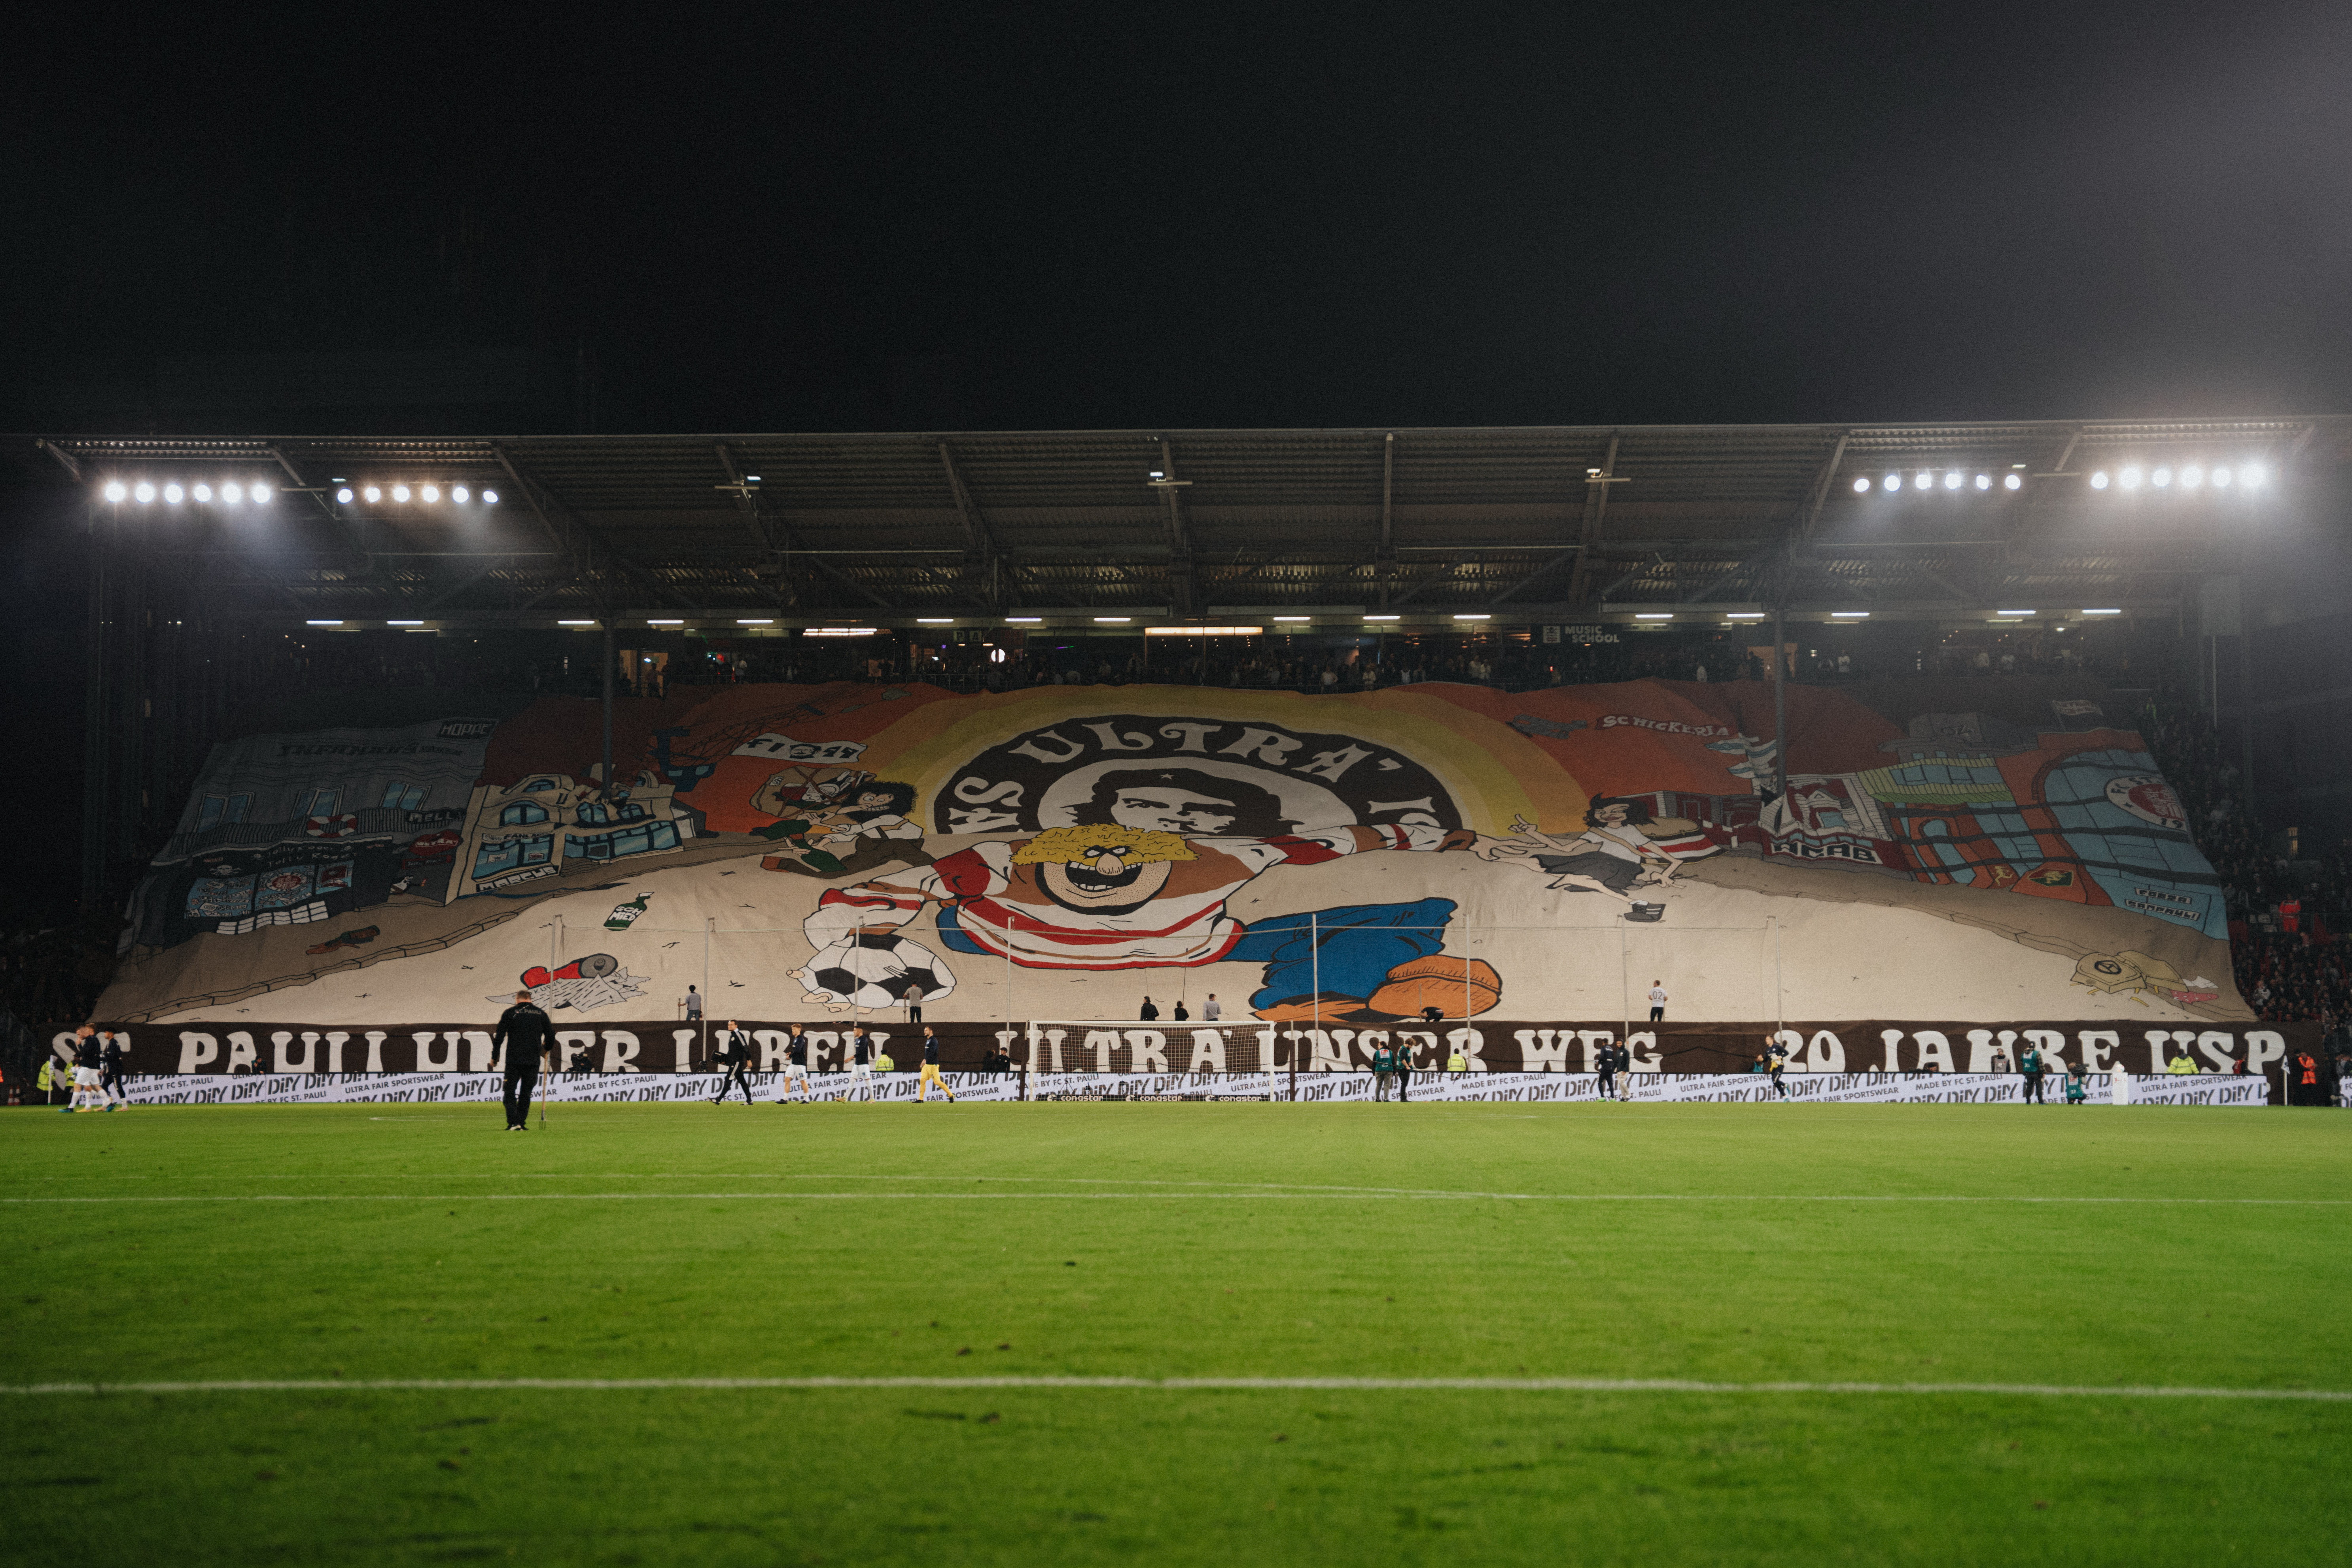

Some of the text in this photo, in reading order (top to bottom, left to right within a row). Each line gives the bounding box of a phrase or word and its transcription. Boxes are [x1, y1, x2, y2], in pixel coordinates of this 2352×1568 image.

[1572, 634, 1620, 643] SCHOOL
[1603, 715, 1729, 736] SCHICKERIA
[1774, 842, 1877, 862] ACAB
[479, 866, 556, 891] MARCUS
[2139, 889, 2186, 903] FORZA
[615, 906, 643, 916] SCH
[2128, 900, 2197, 919] SAMPAULI
[178, 1031, 388, 1073] PAULI
[1514, 1029, 1663, 1073] WEG
[1773, 1029, 1846, 1072] 20
[1869, 1029, 2120, 1073] JAHRE
[2144, 1030, 2286, 1074] USP
[128, 1086, 151, 1094] MADE
[191, 1077, 213, 1086] PAULI
[345, 1085, 370, 1094] ULTRA
[391, 1073, 444, 1086] SPORTSWEAR
[635, 1075, 657, 1084] PAULI
[814, 1081, 831, 1089] FAIR
[1077, 1074, 1099, 1083] PAULI
[1680, 1084, 1705, 1092] ULTRA
[1728, 1074, 1771, 1085] SPORTSWE
[2142, 1084, 2167, 1092] ULTRA
[2191, 1074, 2247, 1086] SPORTSWEAR
[751, 1089, 769, 1097] AULI
[1231, 1082, 1255, 1091] ULTRA
[1844, 1087, 1900, 1100] SPORTSWEAR
